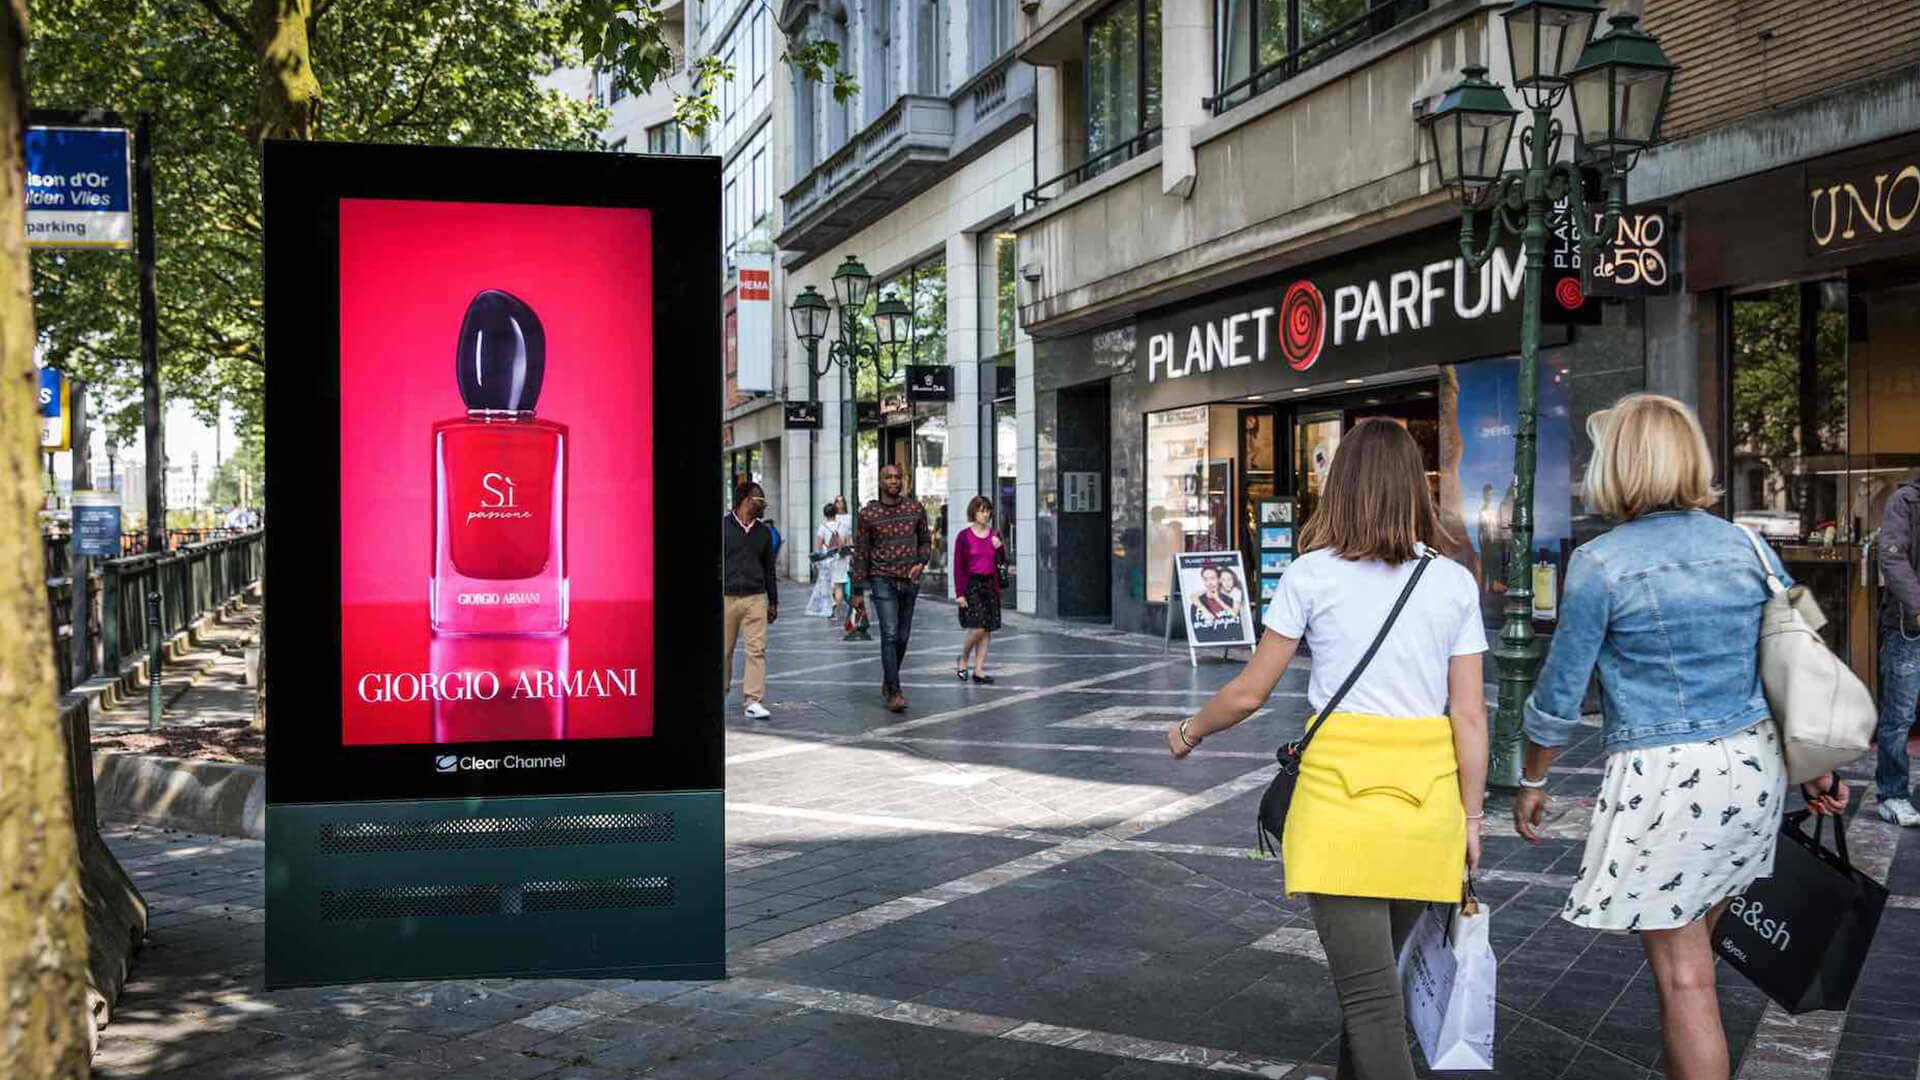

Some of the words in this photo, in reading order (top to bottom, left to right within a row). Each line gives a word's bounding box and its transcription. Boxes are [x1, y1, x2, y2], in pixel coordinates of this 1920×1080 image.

[27, 171, 65, 187] ison
[70, 172, 109, 187] d'Or
[70, 190, 112, 206] Vlies
[1811, 165, 1920, 246] UNO
[27, 221, 86, 236] parking
[1553, 195, 1569, 268] PLANE
[739, 280, 769, 290] HEMA
[1148, 306, 1276, 383] PLANET
[1333, 242, 1528, 346] PARFUM
[480, 472, 519, 508] Sì
[458, 592, 500, 605] GIORGIO
[502, 591, 541, 604] ARMANI
[357, 670, 500, 703] GIORGIO
[511, 668, 638, 699] ARMANI
[459, 756, 501, 771] Clear
[503, 754, 567, 770] Channel
[1729, 896, 1792, 951] a&sh
